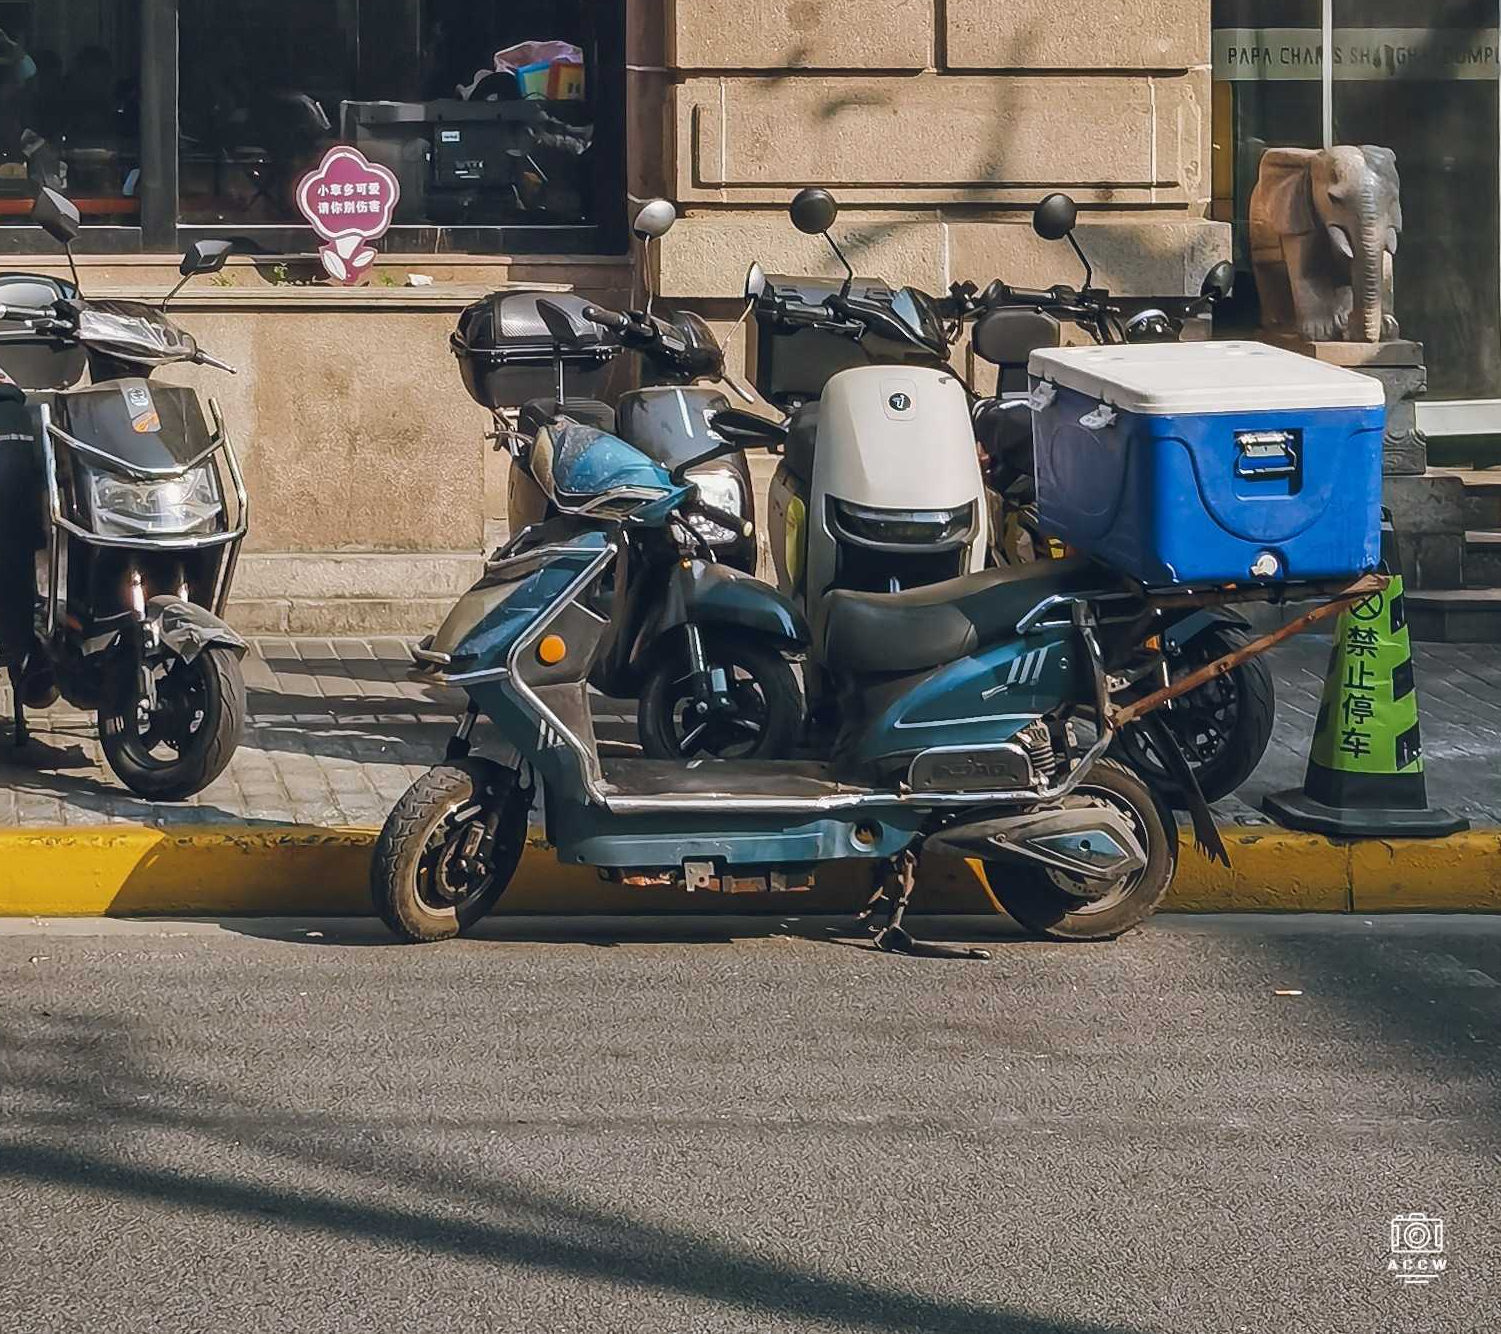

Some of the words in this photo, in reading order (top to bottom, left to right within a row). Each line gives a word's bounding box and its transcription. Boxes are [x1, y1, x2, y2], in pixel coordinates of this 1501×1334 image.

[1228, 47, 1273, 65] PAPA
[317, 182, 381, 197] 小草多可爱
[317, 200, 381, 215] 请你别伤害
[1339, 625, 1379, 759] 禁止停车
